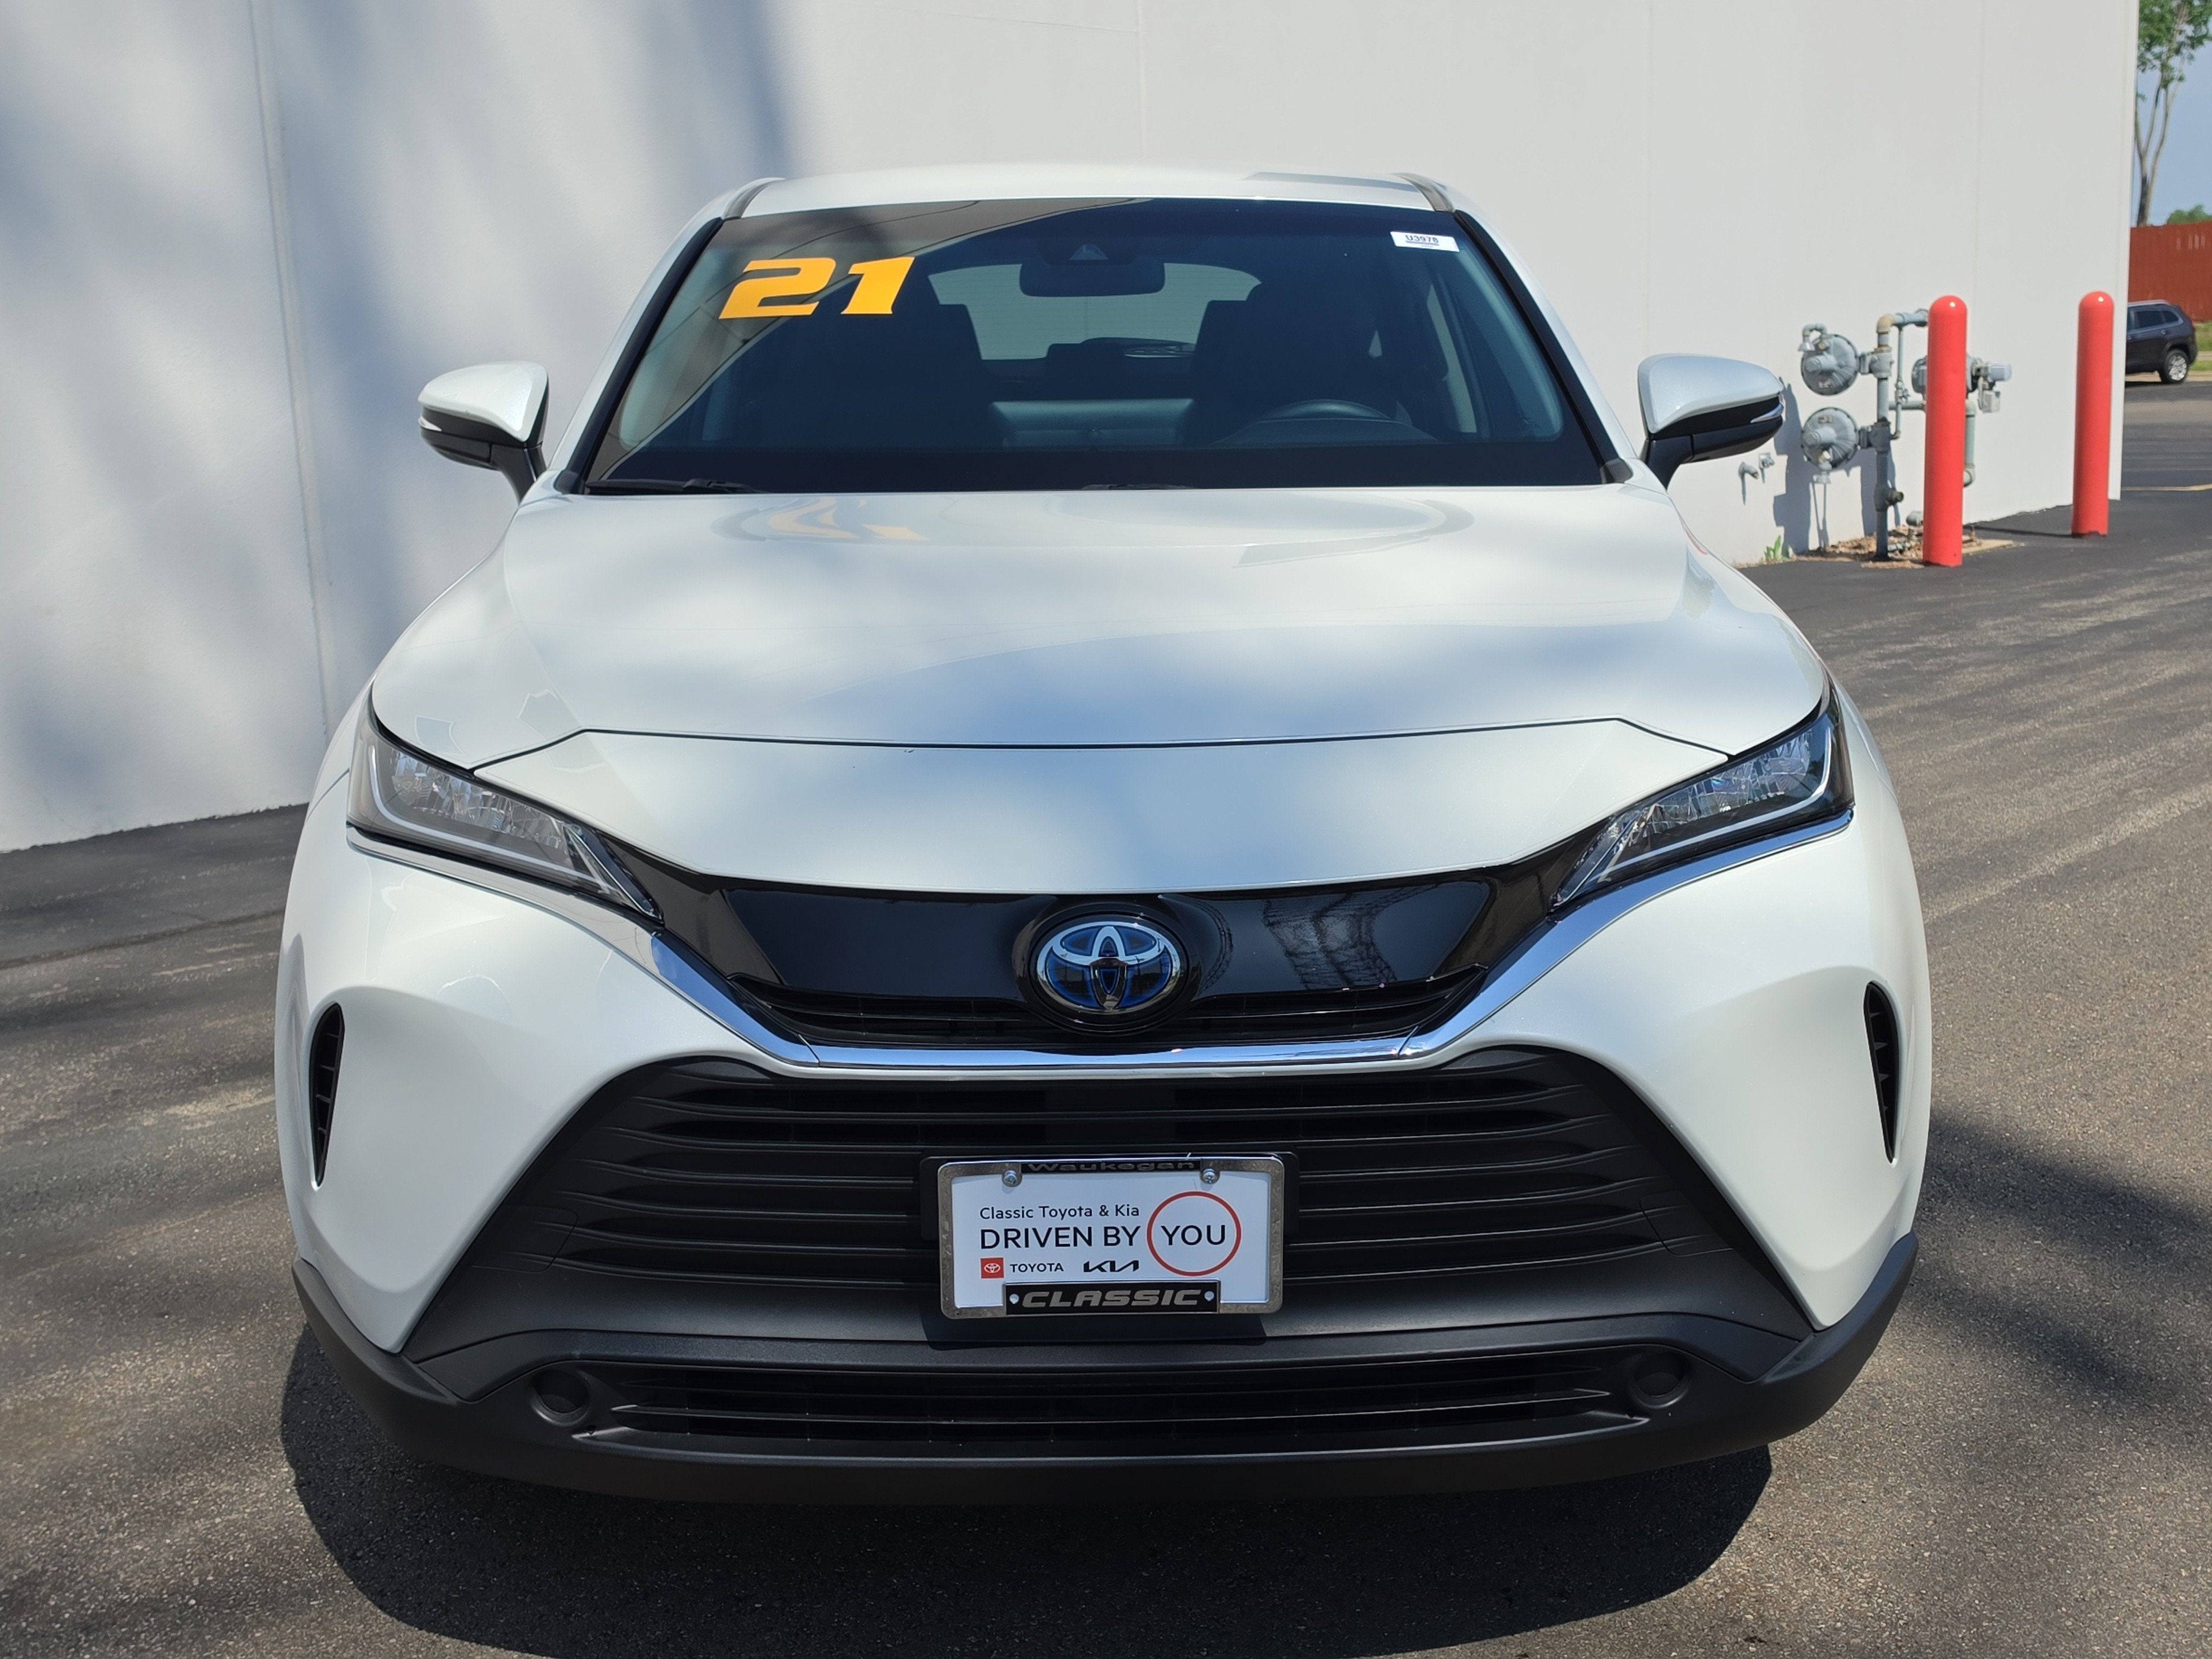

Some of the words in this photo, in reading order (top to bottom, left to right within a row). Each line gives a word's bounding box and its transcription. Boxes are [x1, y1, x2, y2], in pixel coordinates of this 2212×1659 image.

[719, 256, 915, 319] 21
[1028, 1161, 1194, 1171] Waukegan
[980, 1206, 1033, 1219] Classic
[1039, 1205, 1092, 1220] Toyota
[1099, 1205, 1109, 1217] &
[1115, 1204, 1140, 1217] Kia
[981, 1227, 1092, 1249] DRIVEN
[1104, 1225, 1141, 1246] BY
[1160, 1224, 1226, 1245] YOU
[1010, 1262, 1064, 1273] TOYOTA
[1022, 1289, 1201, 1308] CLASSIC
